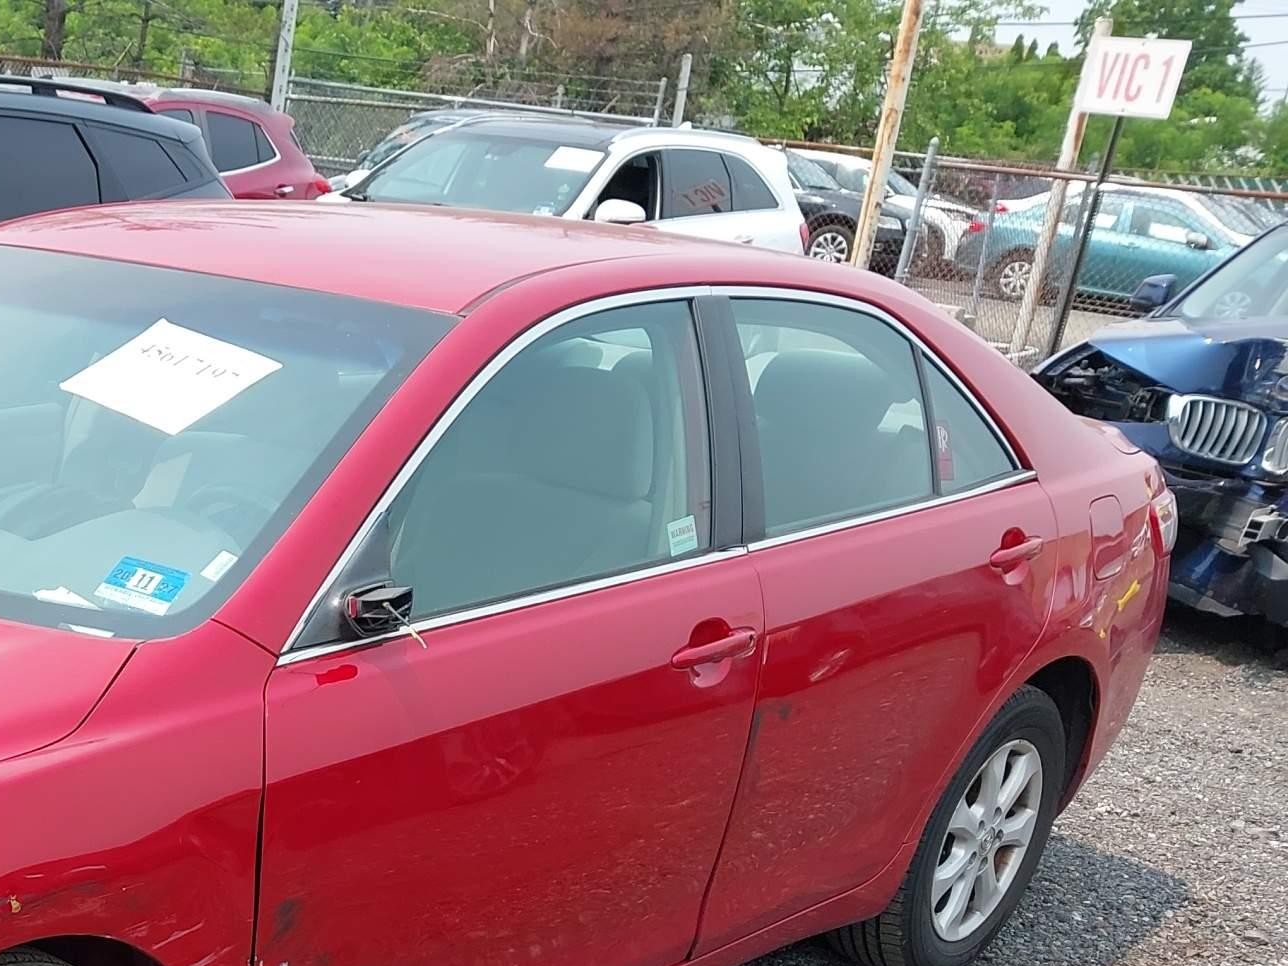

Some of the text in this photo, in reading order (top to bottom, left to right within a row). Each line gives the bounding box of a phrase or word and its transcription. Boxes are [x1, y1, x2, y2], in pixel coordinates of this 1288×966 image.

[1096, 51, 1176, 104] VIC 1
[133, 572, 156, 591] 11
